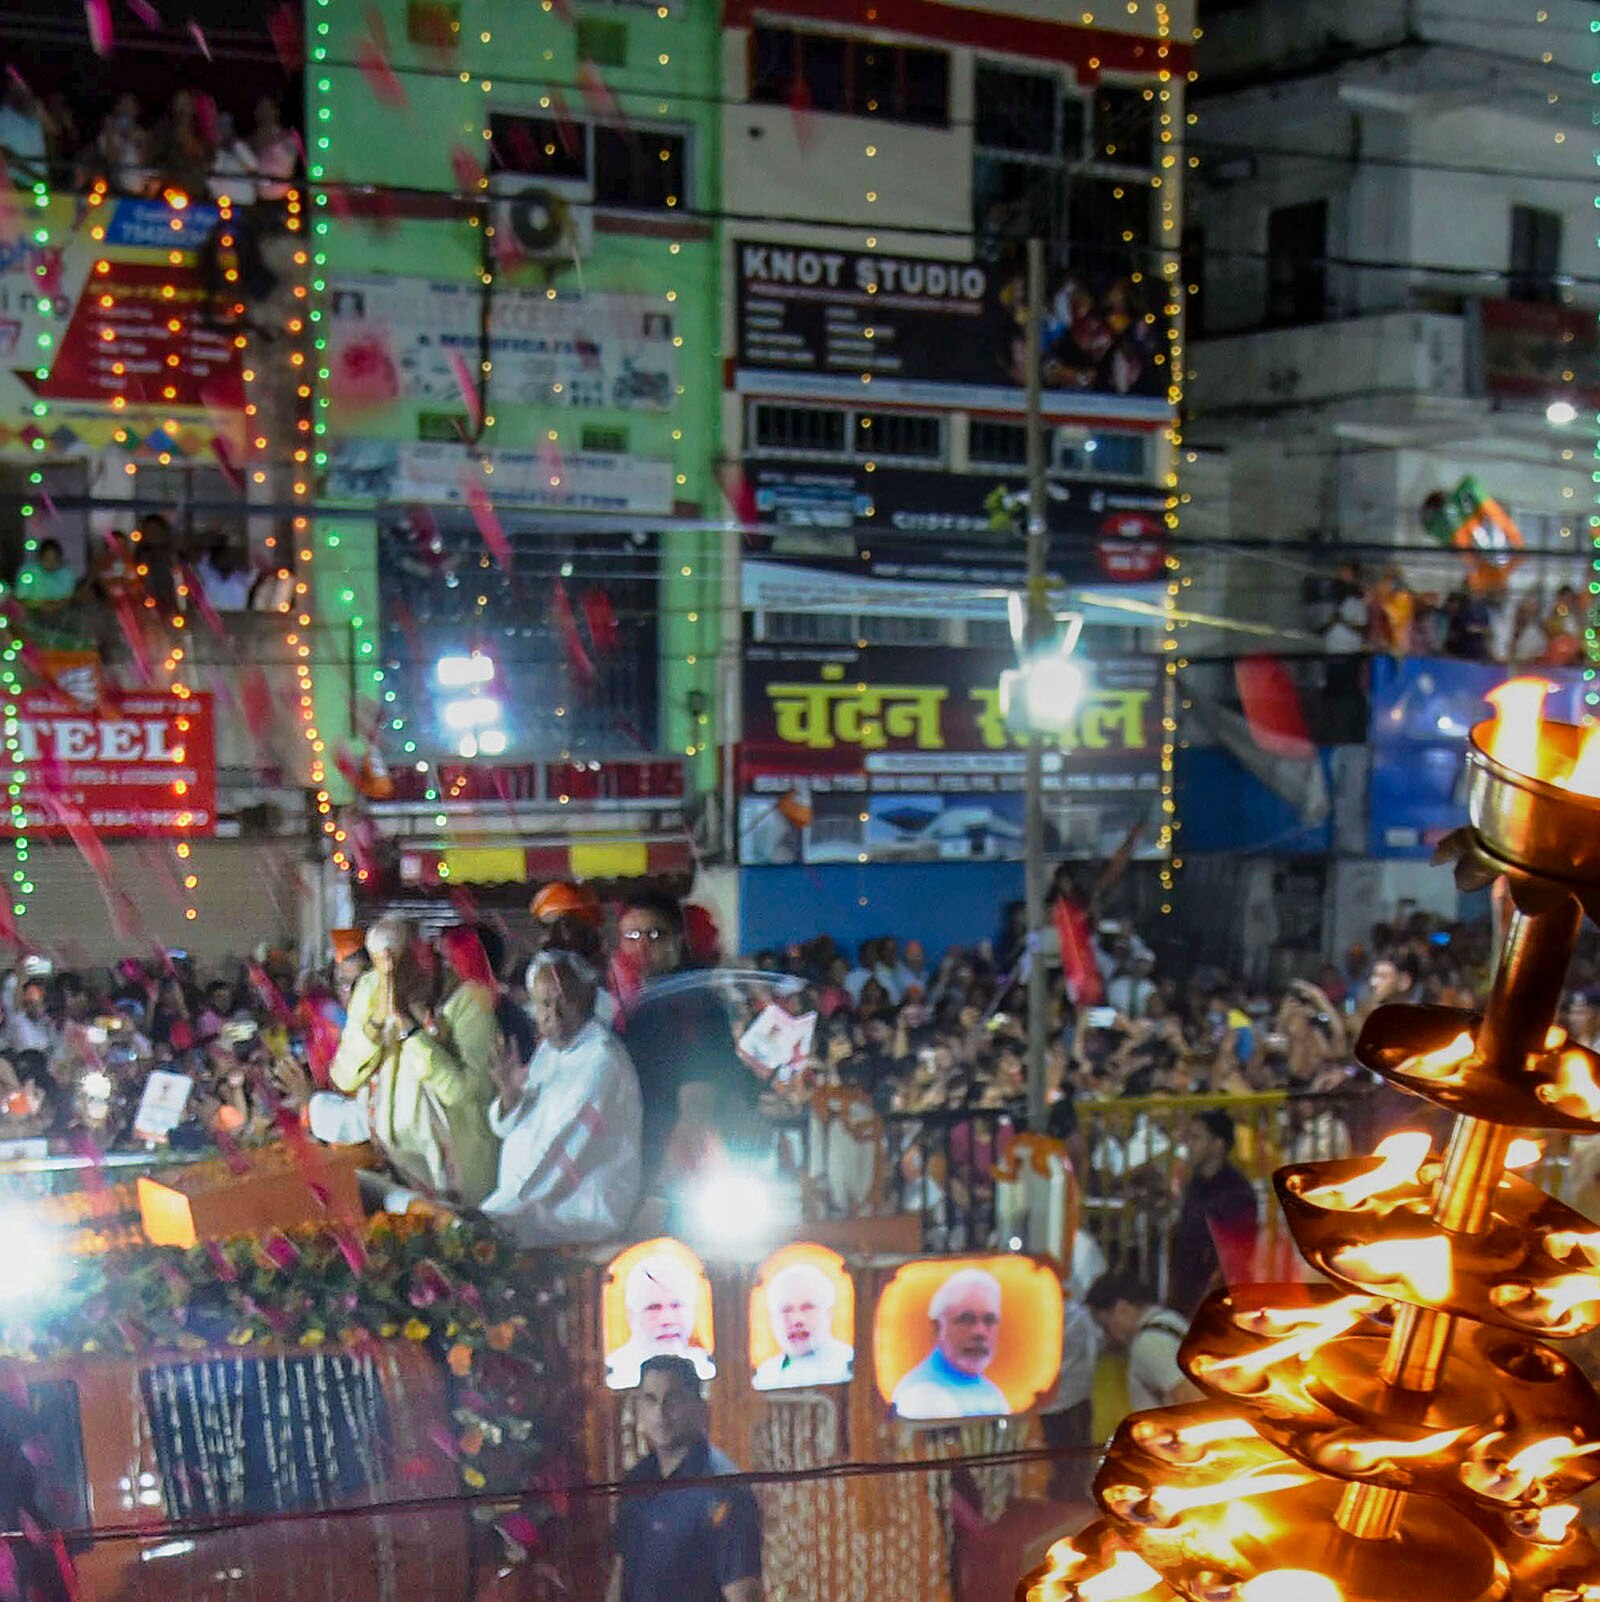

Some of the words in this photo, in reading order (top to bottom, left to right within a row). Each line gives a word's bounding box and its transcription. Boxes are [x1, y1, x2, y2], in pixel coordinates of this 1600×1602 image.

[743, 246, 846, 286] KNOT
[855, 257, 987, 299] STUDIO
[766, 663, 949, 749] चंदन
